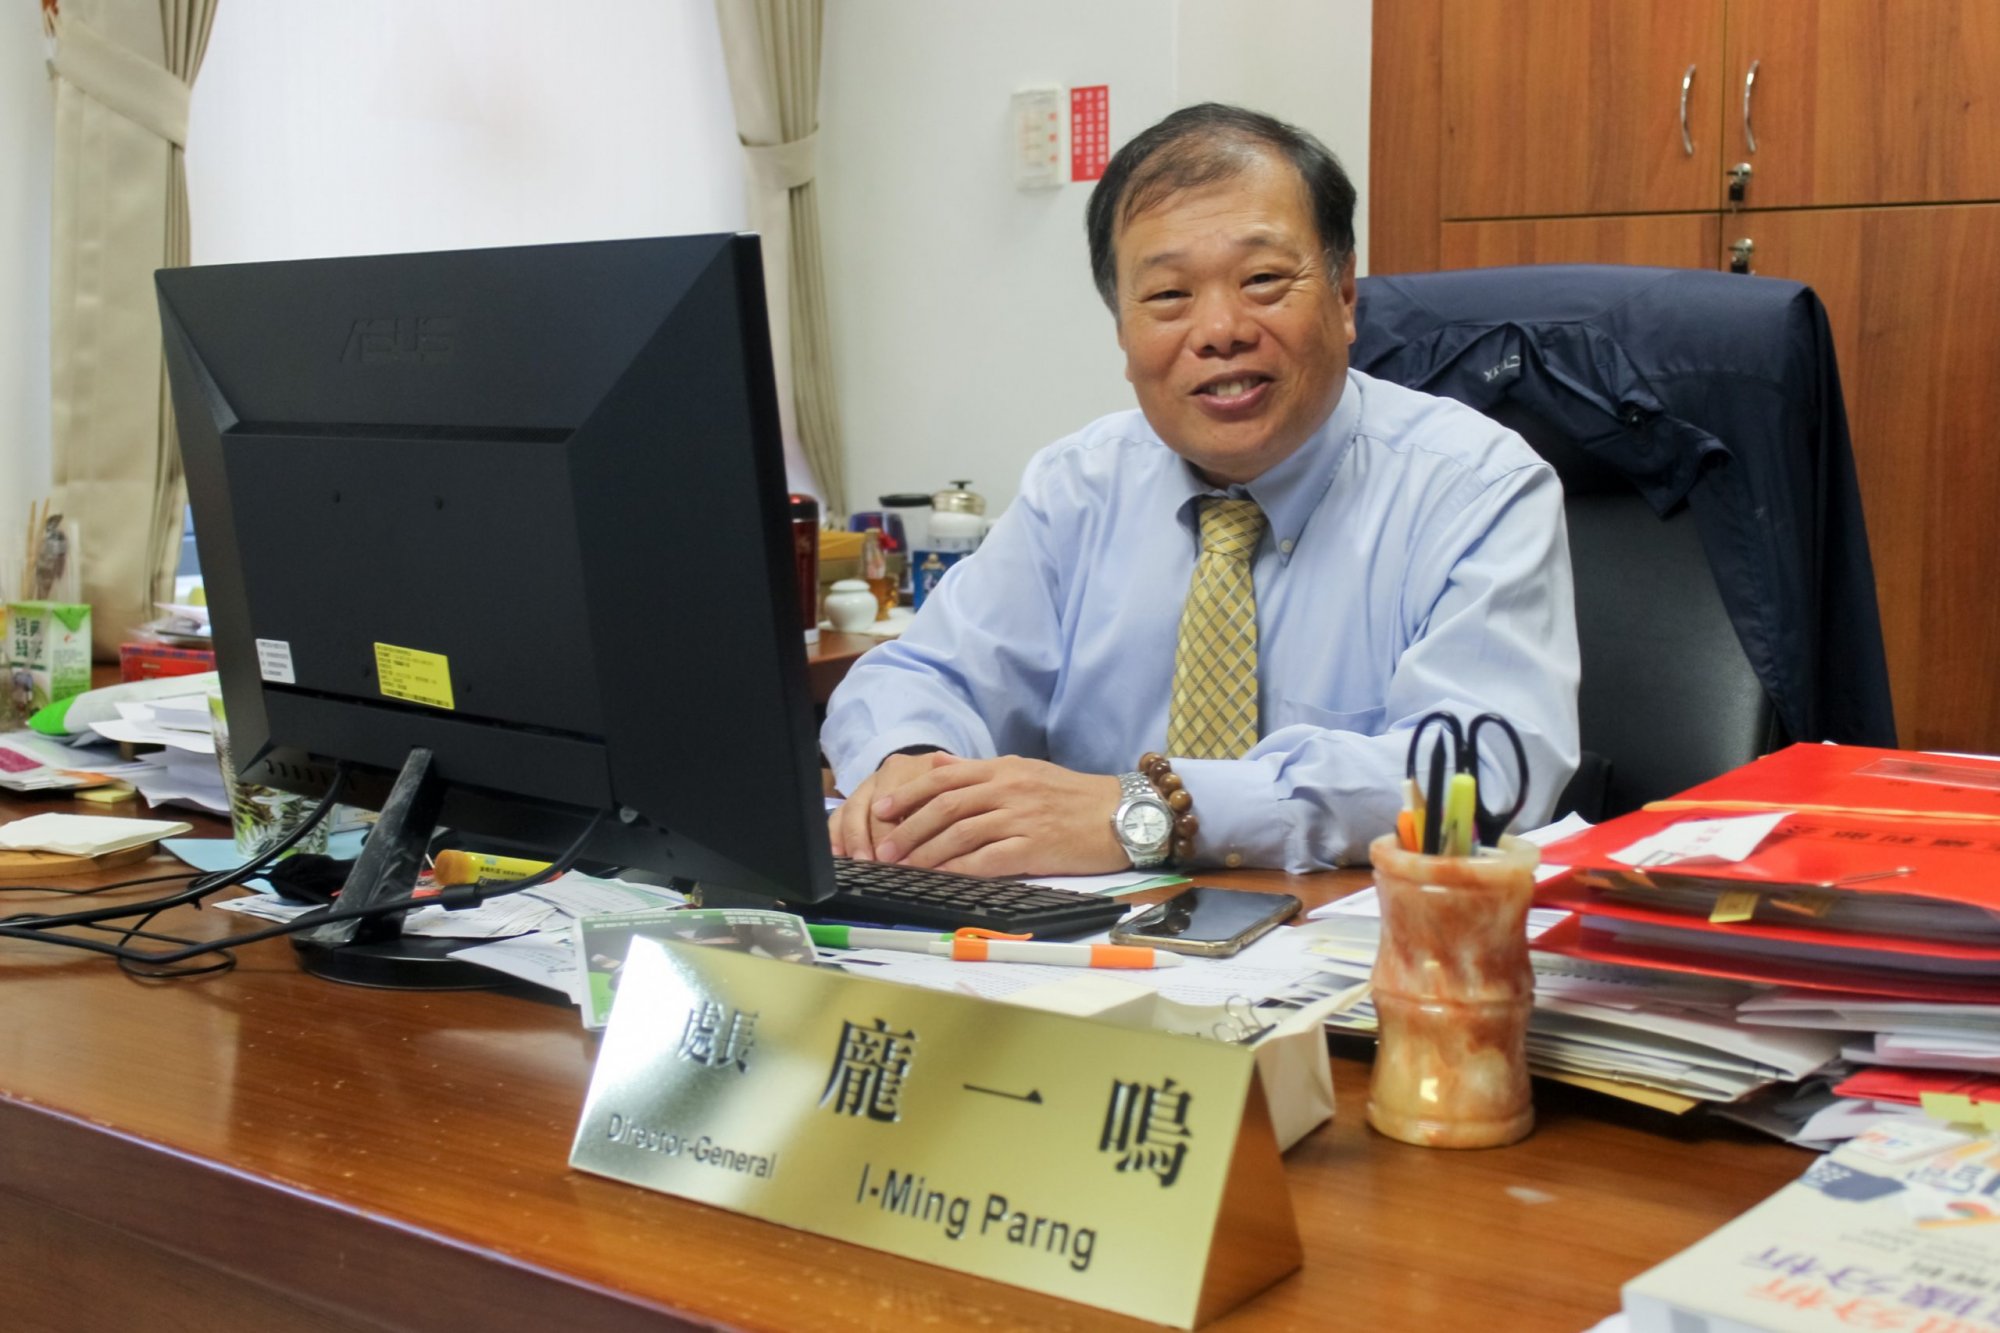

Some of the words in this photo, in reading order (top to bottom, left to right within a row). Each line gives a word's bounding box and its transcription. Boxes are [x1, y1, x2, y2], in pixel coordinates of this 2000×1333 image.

[678, 1000, 759, 1074] 處長
[607, 1113, 777, 1179] Director-General
[856, 1162, 971, 1241] I-Ming
[980, 1193, 1098, 1272] Parng
